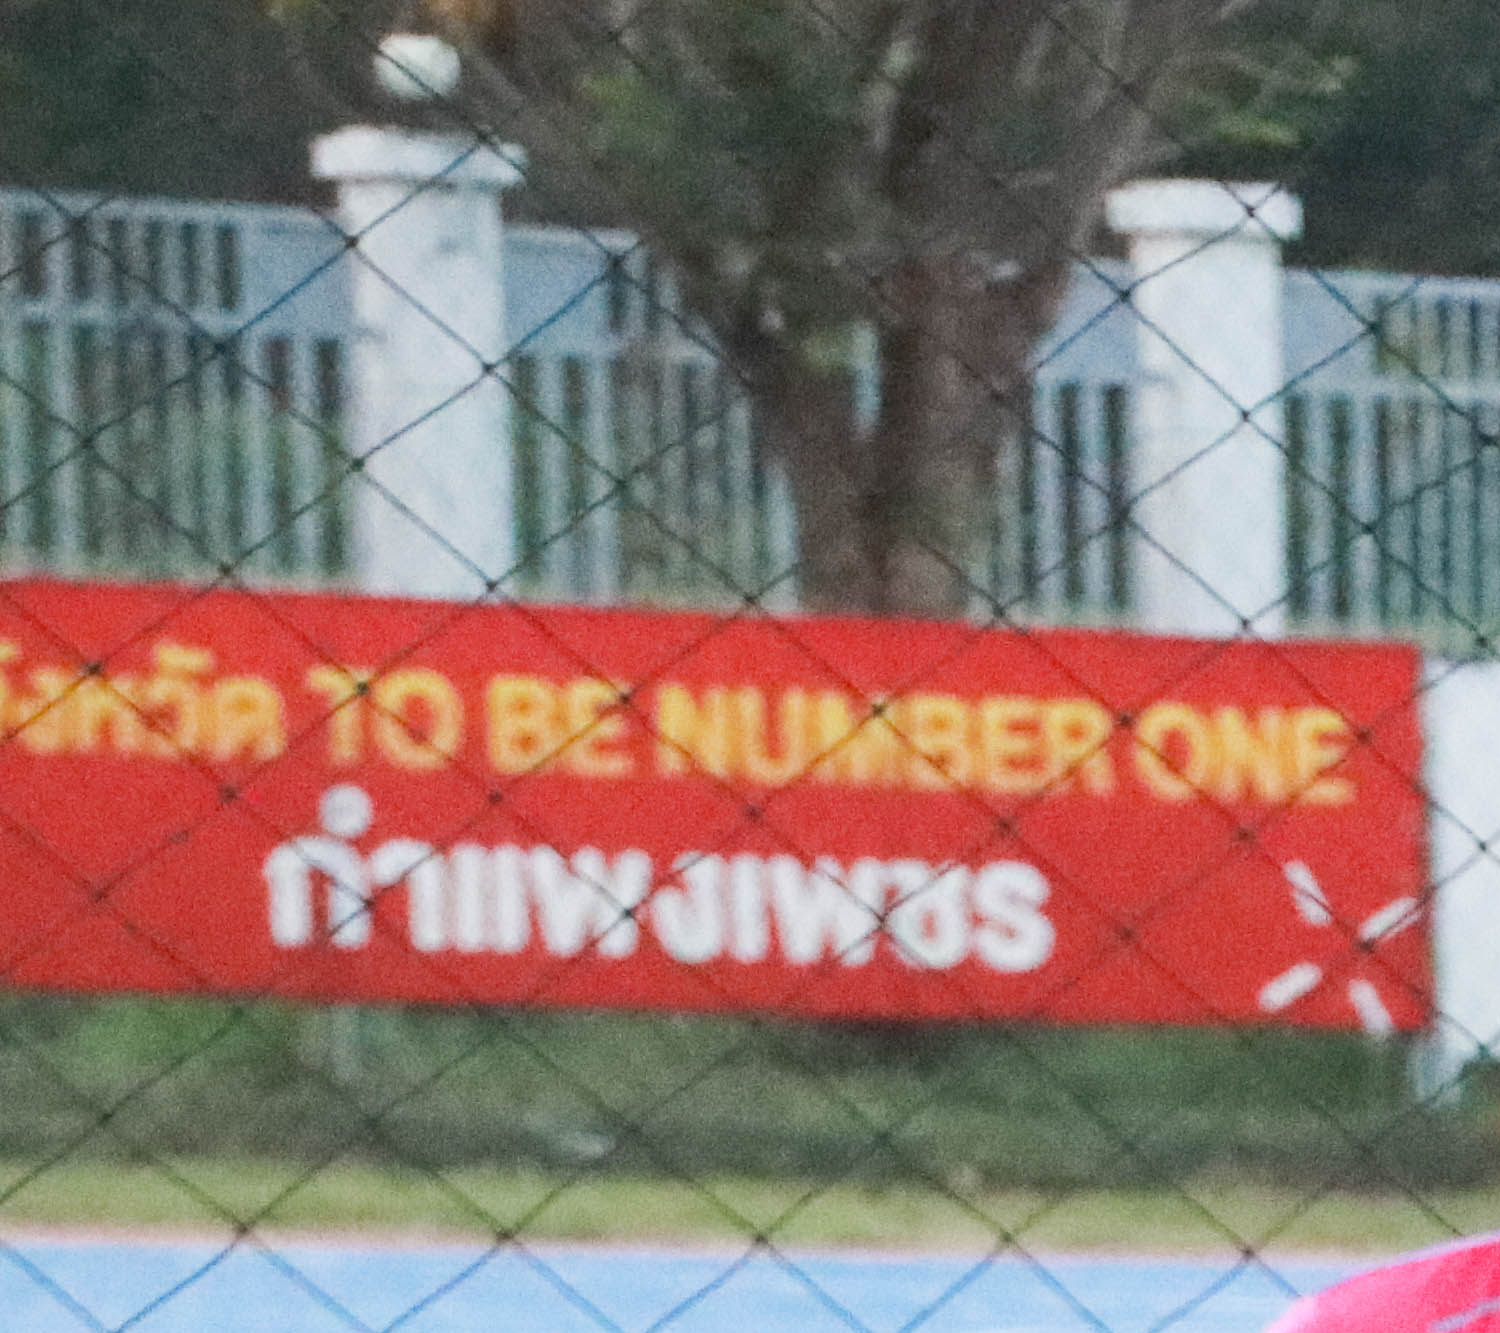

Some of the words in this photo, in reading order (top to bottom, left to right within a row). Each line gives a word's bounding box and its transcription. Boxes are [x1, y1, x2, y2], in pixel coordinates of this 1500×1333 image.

[305, 664, 466, 770] TO
[486, 674, 637, 780] BE
[655, 680, 1119, 802] NUMBER
[1132, 700, 1357, 805] ONE
[262, 782, 1058, 974] กำแพงเพชร
